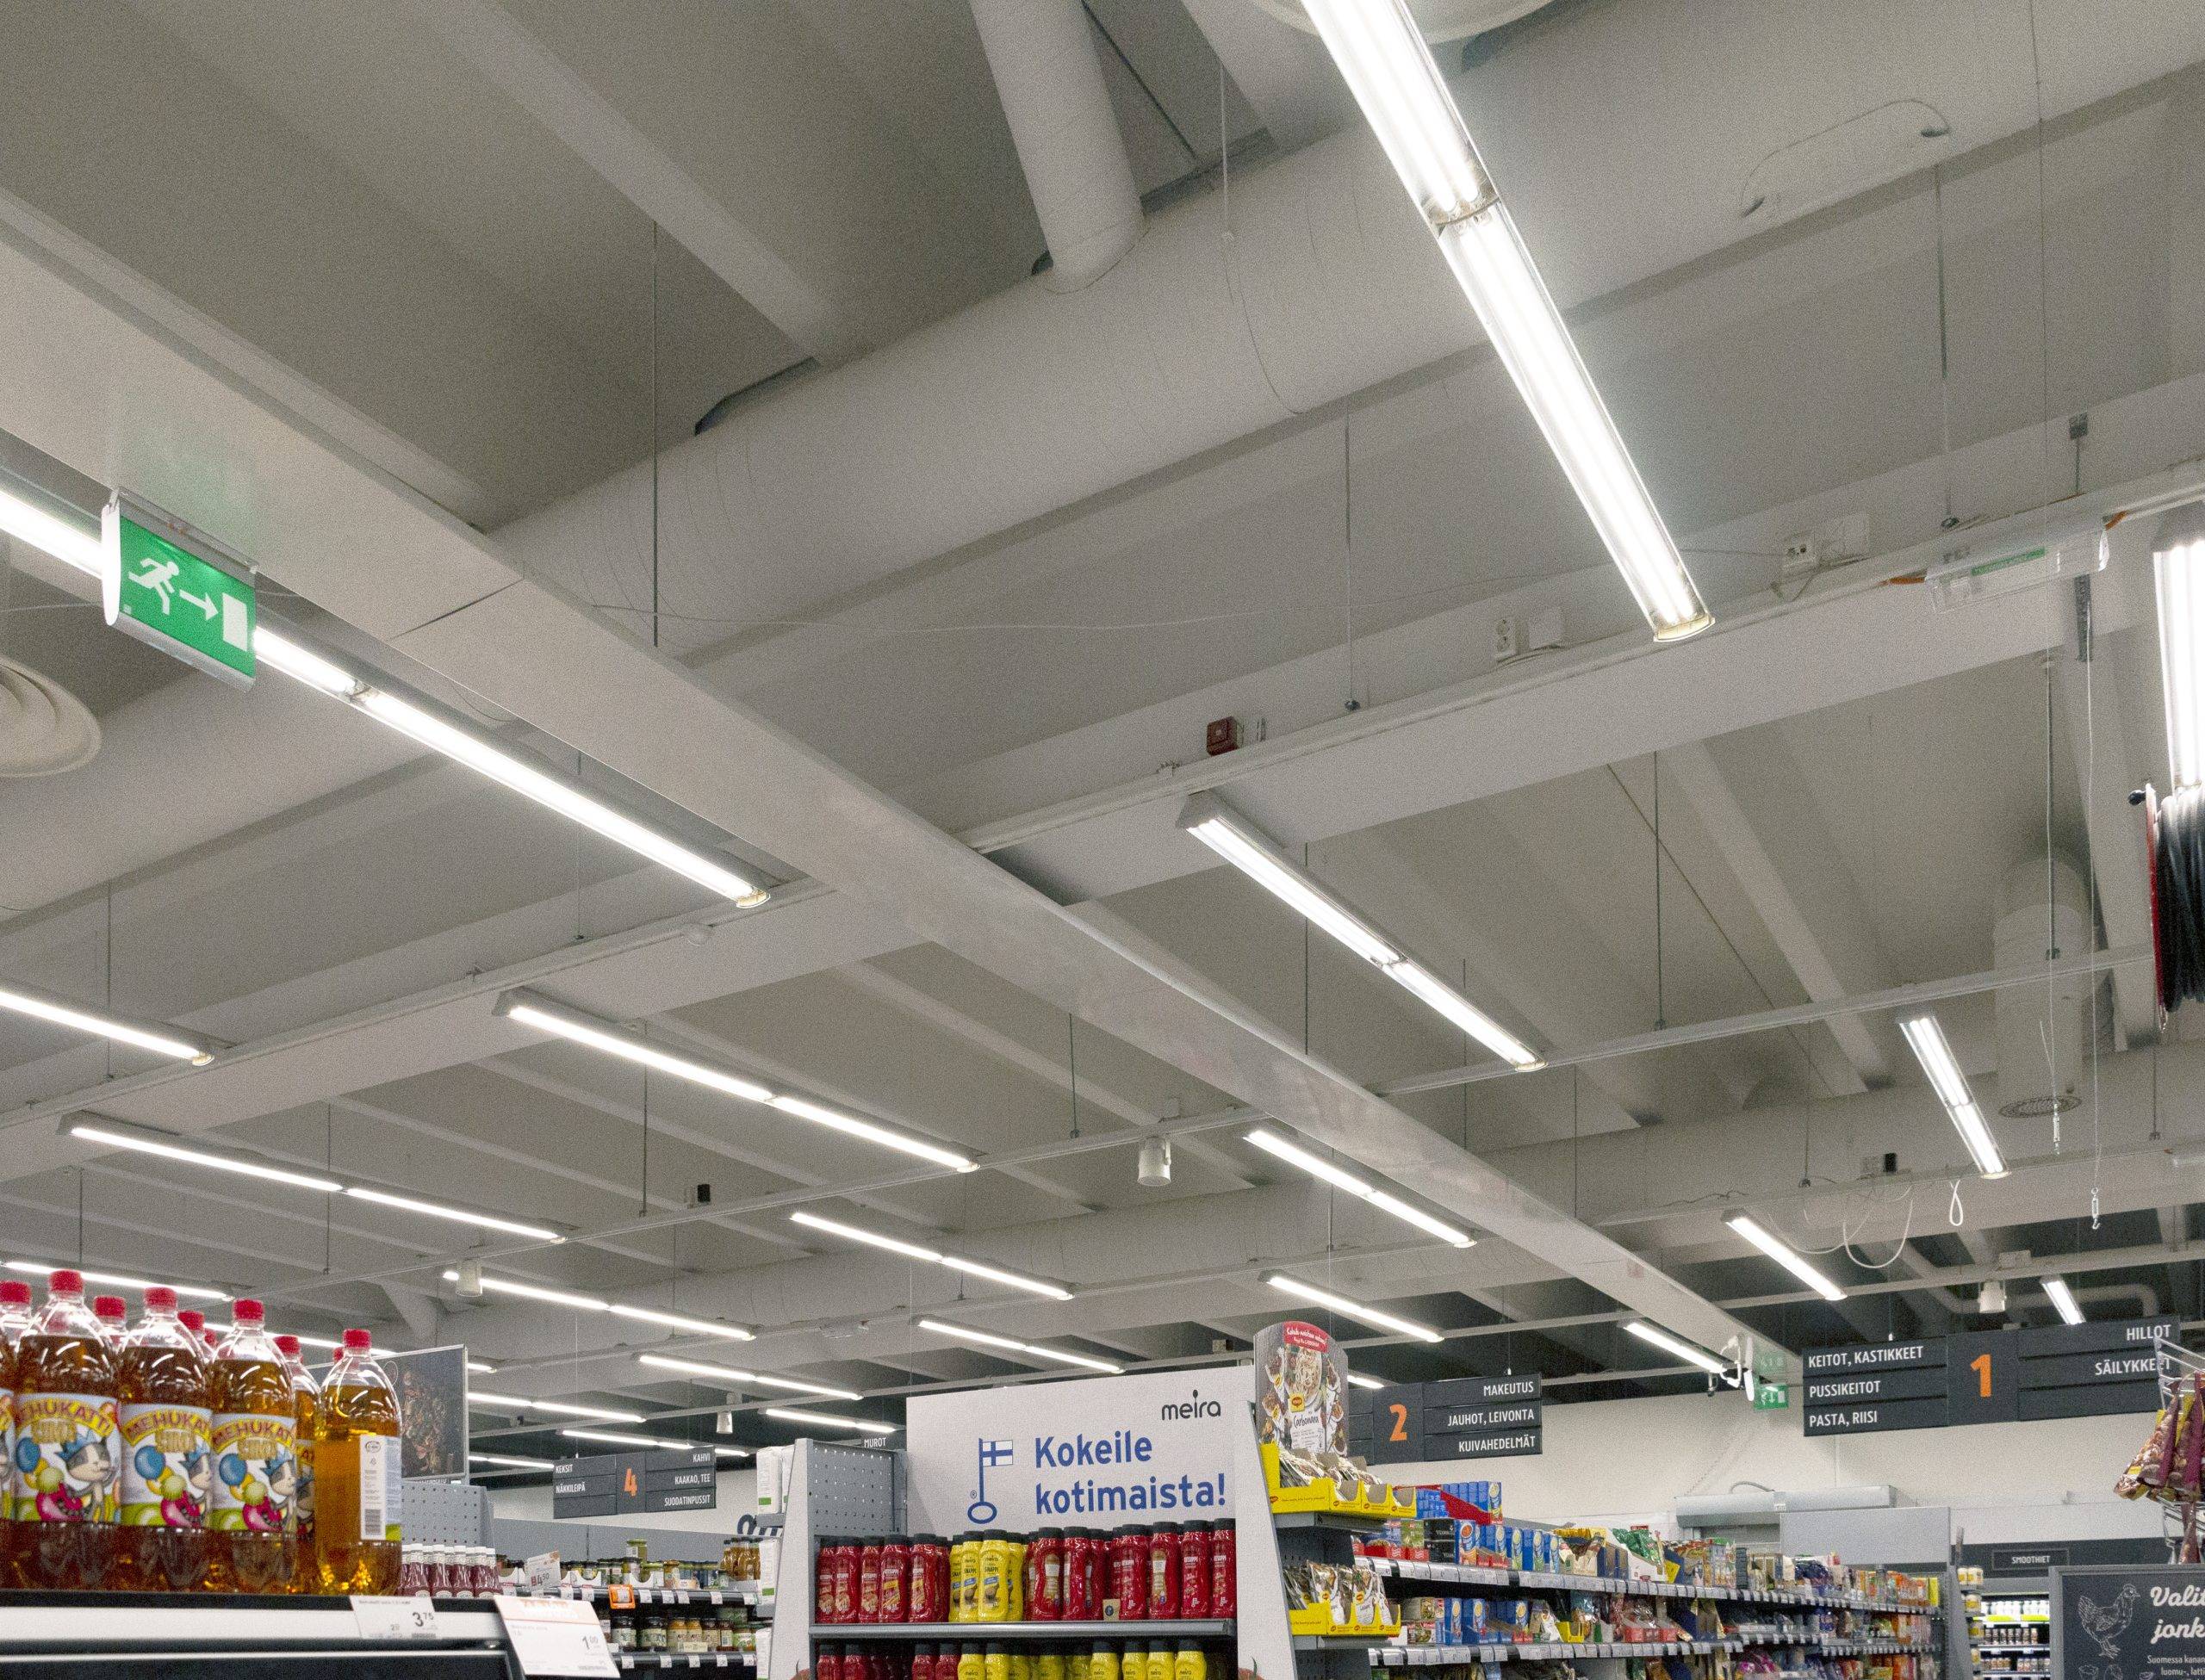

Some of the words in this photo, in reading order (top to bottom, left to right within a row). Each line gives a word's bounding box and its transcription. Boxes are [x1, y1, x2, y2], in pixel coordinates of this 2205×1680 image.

[2126, 1324, 2171, 1341] HILLOT
[1809, 1353, 1852, 1367] KEITOT,
[1854, 1346, 1923, 1363] KASTIKKEET
[1970, 1354, 1991, 1398] 1
[1483, 1381, 1534, 1397] MAKEUTUS
[1810, 1380, 1881, 1398] PUSSIKEITOT
[1161, 1389, 1221, 1421] meira
[1389, 1404, 1407, 1441] 2
[1447, 1412, 1487, 1426] JAUHOT,
[1488, 1409, 1535, 1423] LEIVONTA
[1809, 1413, 1850, 1428] PASTA,
[1852, 1410, 1878, 1424] RIISI
[864, 1437, 886, 1448] MUROT
[1034, 1429, 1152, 1468] Kokeile
[1458, 1434, 1536, 1453] KUIVAHEDELMÄT
[693, 1453, 711, 1462] KAHVI
[555, 1464, 574, 1473] KEKSIT
[624, 1468, 637, 1497] 4
[701, 1473, 711, 1483] TEE
[556, 1482, 586, 1493] NÄKKILEIPÄ
[1034, 1472, 1226, 1515] kotimaista!
[664, 1494, 711, 1506] SUODATINPUSSIT
[2012, 1555, 2051, 1564] SMOOTHIET
[2150, 1616, 2205, 1644] jonk
[2146, 1654, 2183, 1664] Suomessa
